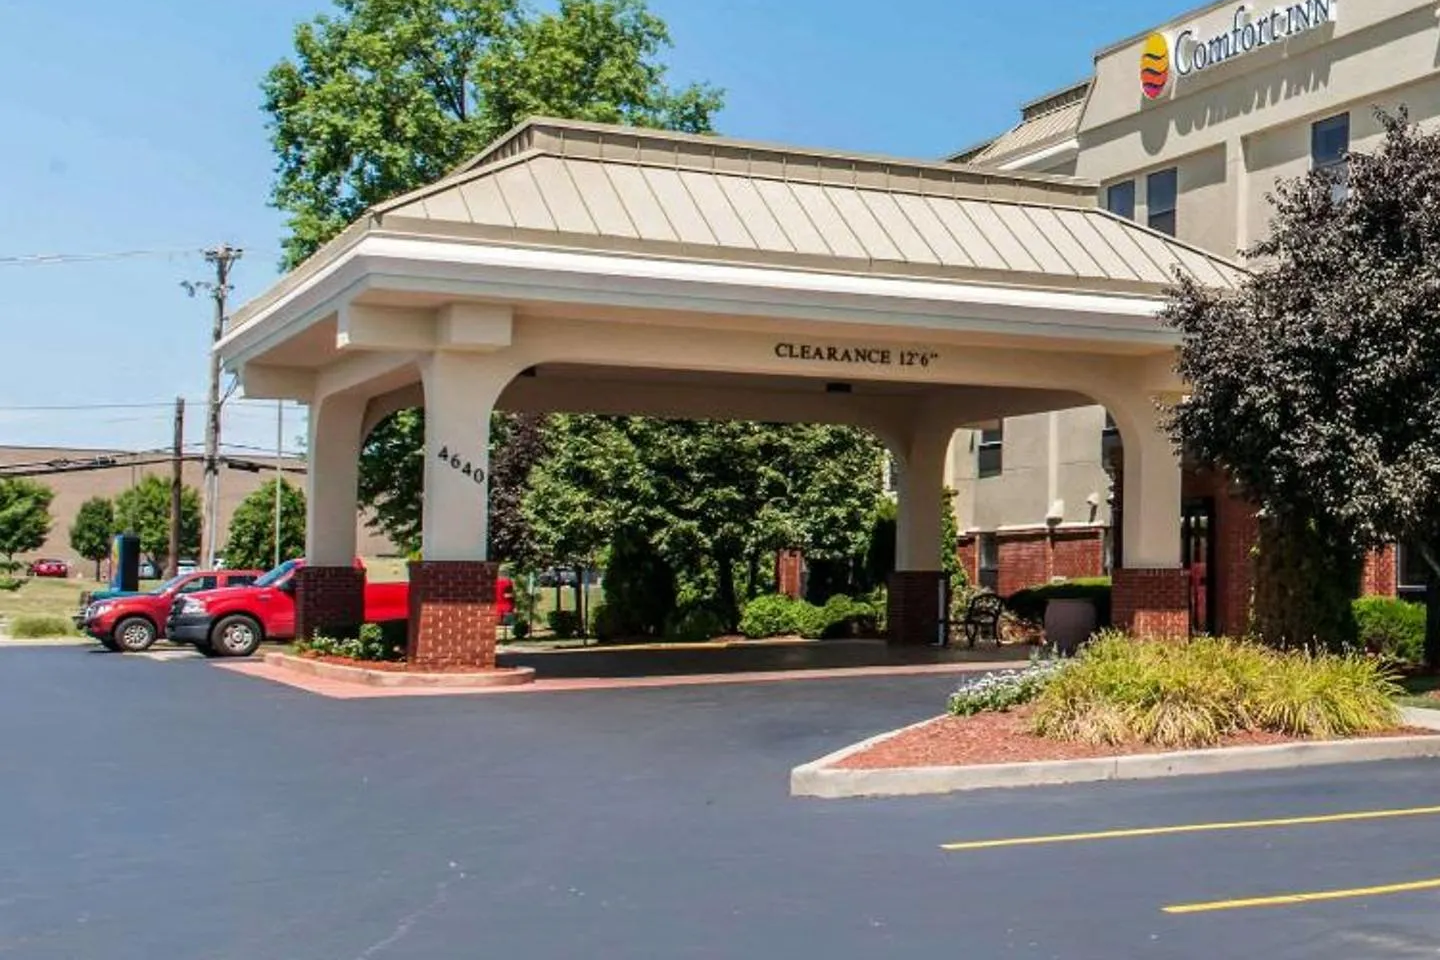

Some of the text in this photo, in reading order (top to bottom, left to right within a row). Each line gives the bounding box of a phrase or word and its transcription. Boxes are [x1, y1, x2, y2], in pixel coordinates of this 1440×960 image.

[1175, 4, 1281, 75] Comfort
[774, 342, 891, 365] CLEARANCE
[437, 445, 485, 484] 4640
